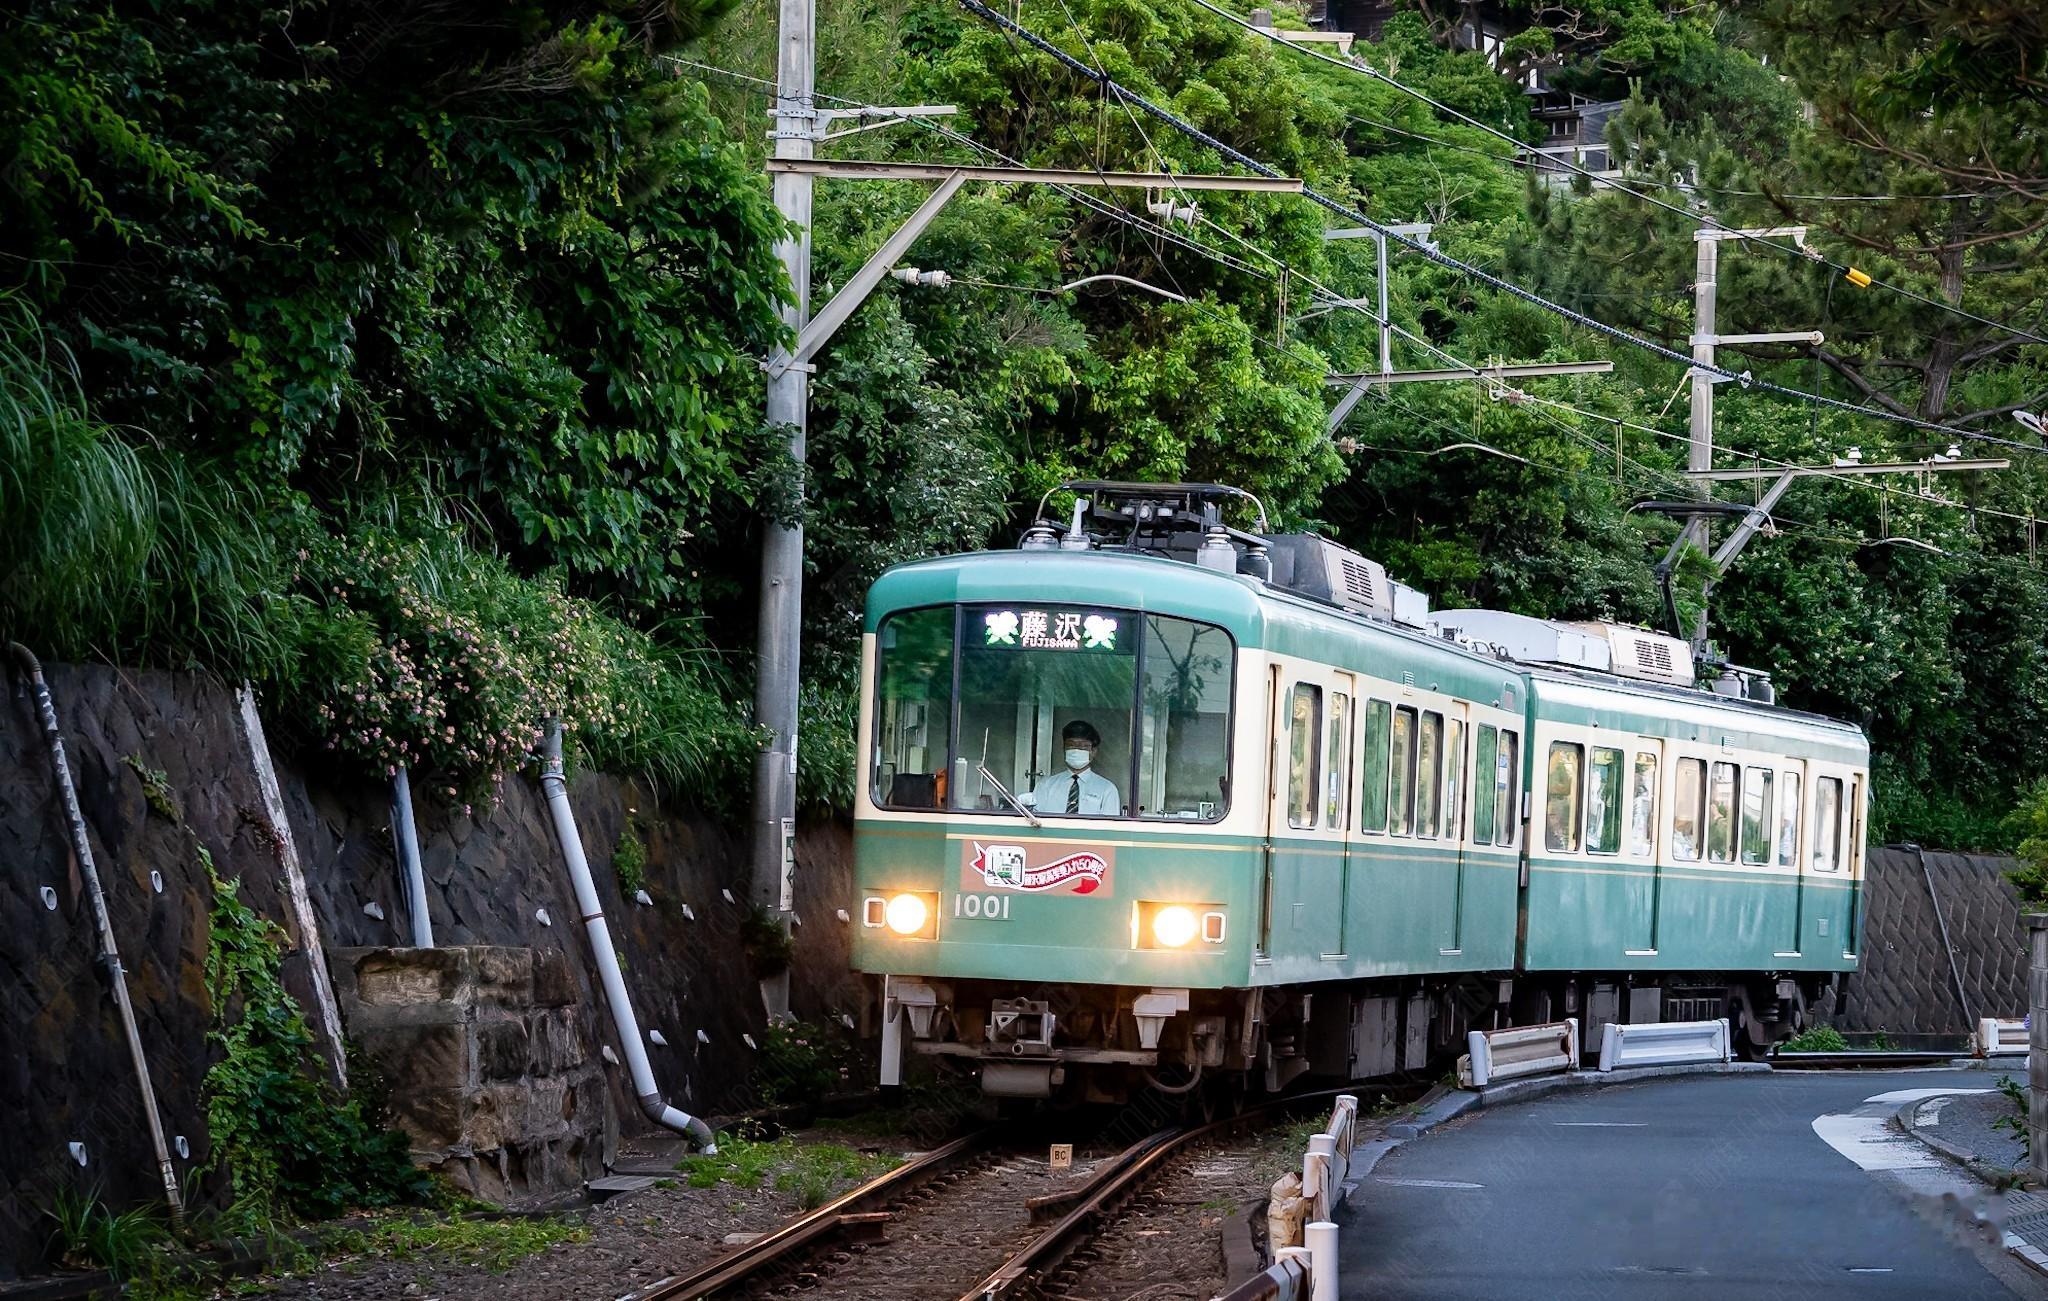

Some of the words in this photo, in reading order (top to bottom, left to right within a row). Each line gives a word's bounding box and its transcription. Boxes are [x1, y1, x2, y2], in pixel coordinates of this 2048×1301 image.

[1020, 611, 1081, 640] 藤沢
[1022, 637, 1078, 648] FUJISAWA
[955, 894, 1009, 918] 1001
[1055, 1150, 1066, 1160] BC
